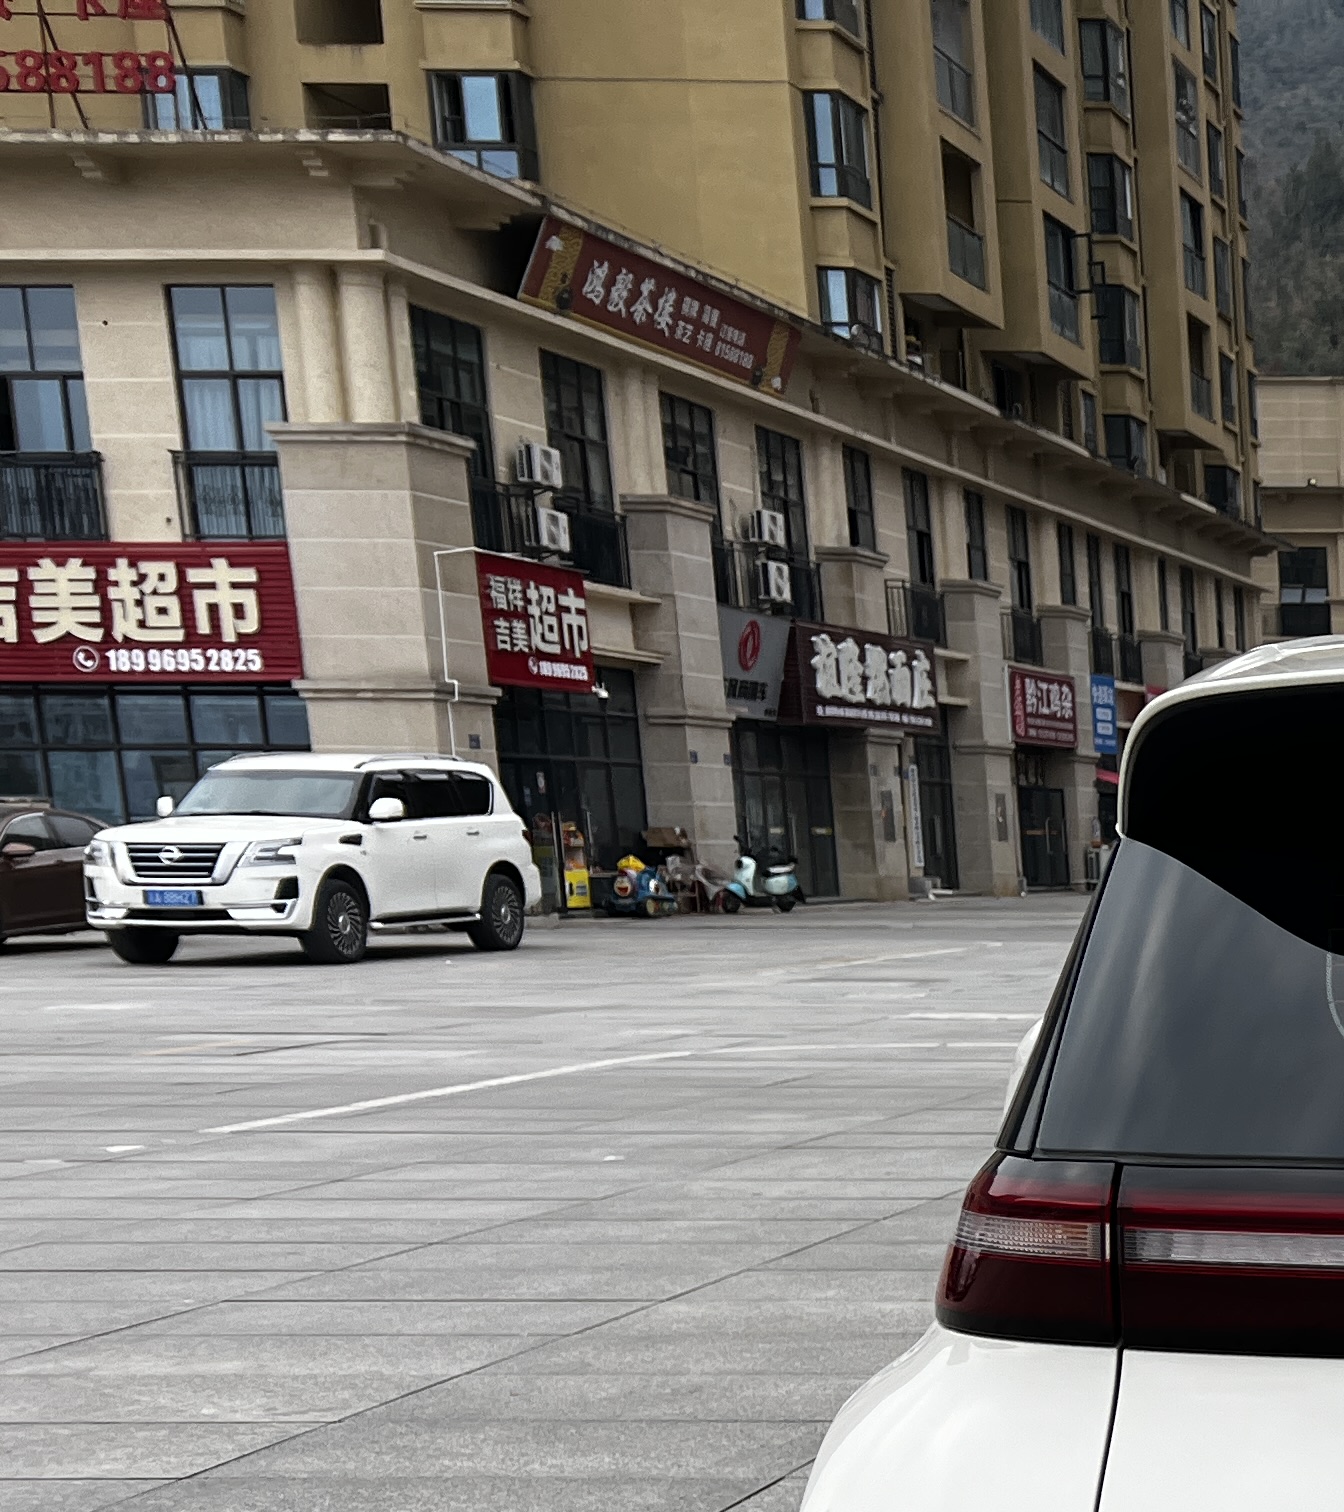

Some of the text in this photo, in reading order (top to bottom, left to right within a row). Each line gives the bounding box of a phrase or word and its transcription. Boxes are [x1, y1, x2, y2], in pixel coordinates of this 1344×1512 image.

[0, 557, 260, 644] 美超市
[526, 580, 589, 658] 超市
[105, 649, 263, 672] 18996952825
